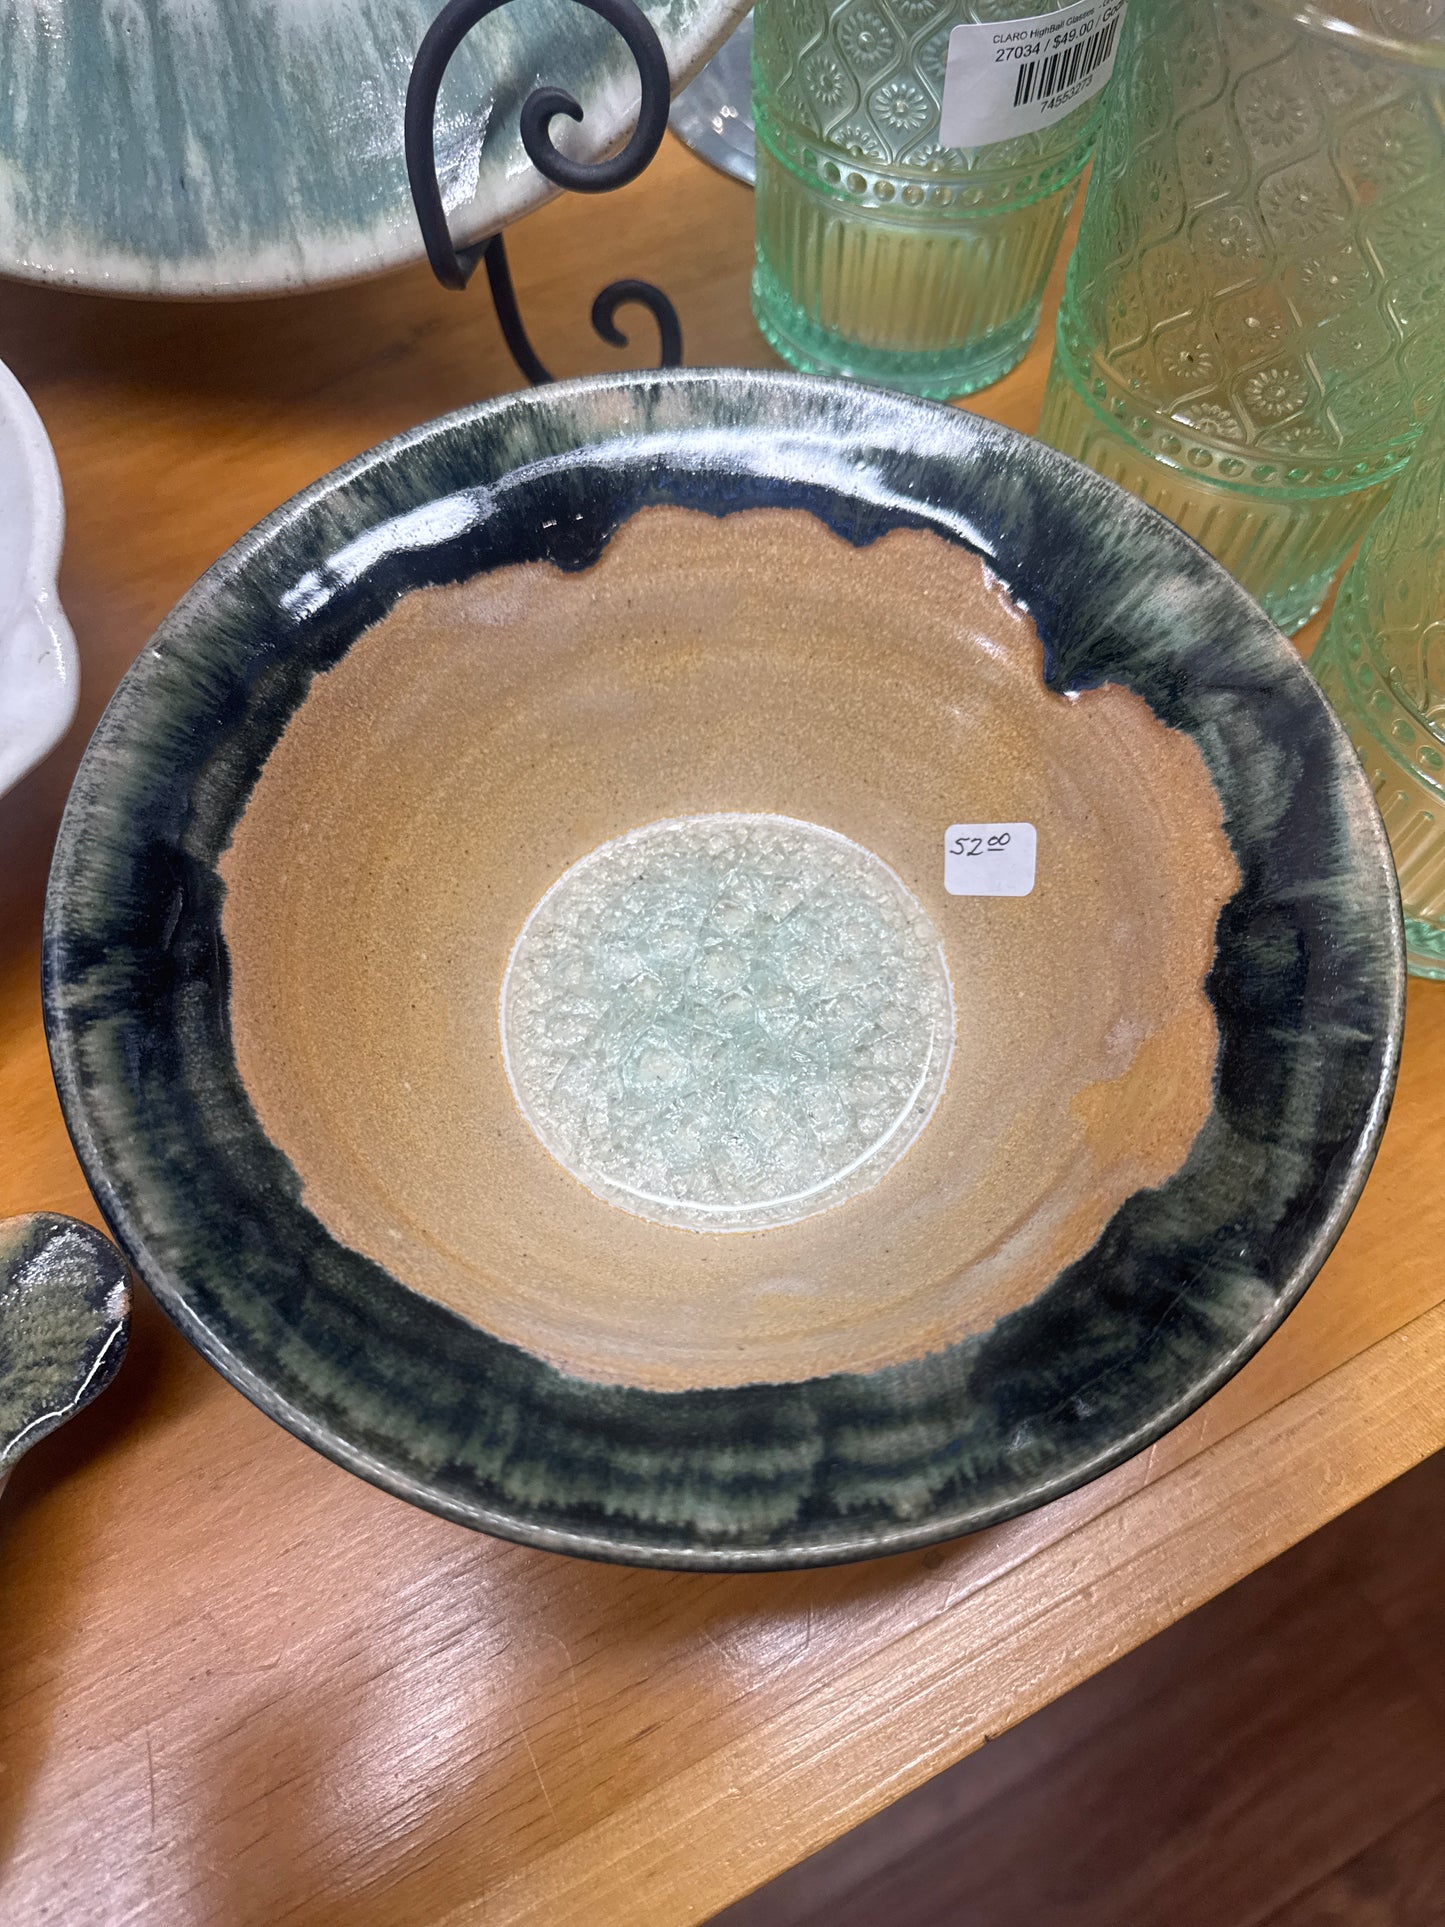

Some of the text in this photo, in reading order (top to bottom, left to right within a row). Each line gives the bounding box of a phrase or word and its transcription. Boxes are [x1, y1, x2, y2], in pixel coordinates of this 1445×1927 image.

[993, 31, 1028, 44] CLARO
[1029, 24, 1065, 39] HighBall
[995, 43, 1041, 63] 27034
[1053, 20, 1094, 49] $49.00
[1040, 74, 1093, 114] 74553273
